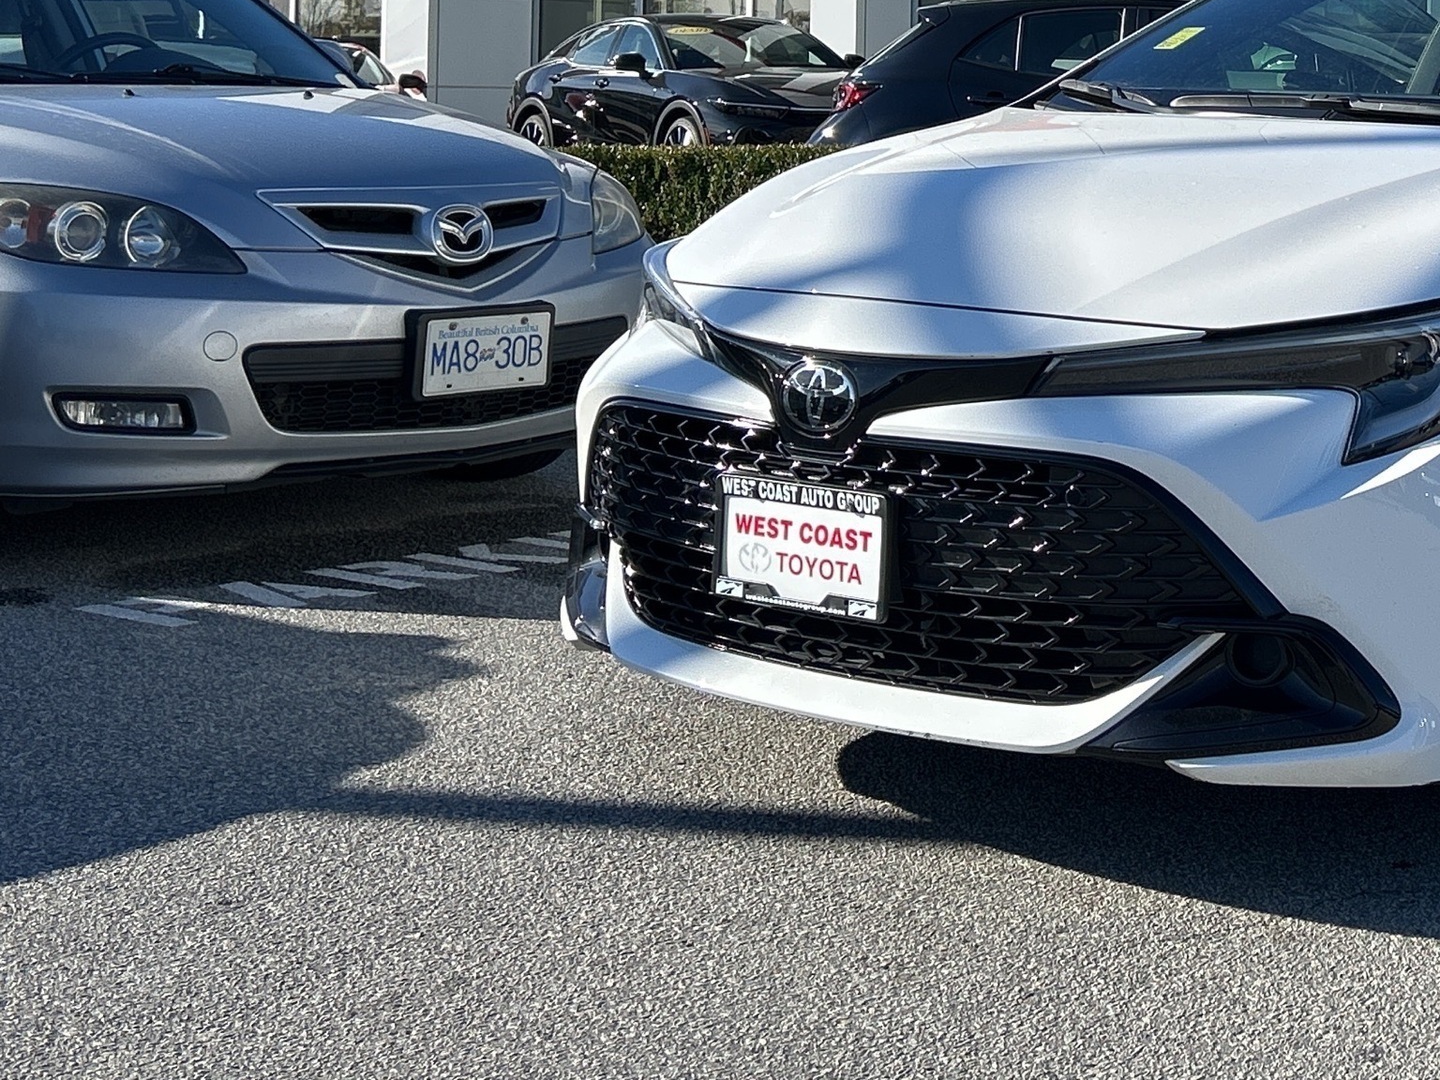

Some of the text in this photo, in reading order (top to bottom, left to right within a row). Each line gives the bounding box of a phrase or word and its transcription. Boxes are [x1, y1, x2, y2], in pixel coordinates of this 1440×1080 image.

[438, 323, 539, 339] Beautiful British Columbia
[431, 338, 480, 376] MA8
[758, 481, 798, 503] COAST
[800, 487, 834, 508] AUTO
[735, 512, 873, 552] WEST COAST
[775, 552, 862, 585] TOYOTA
